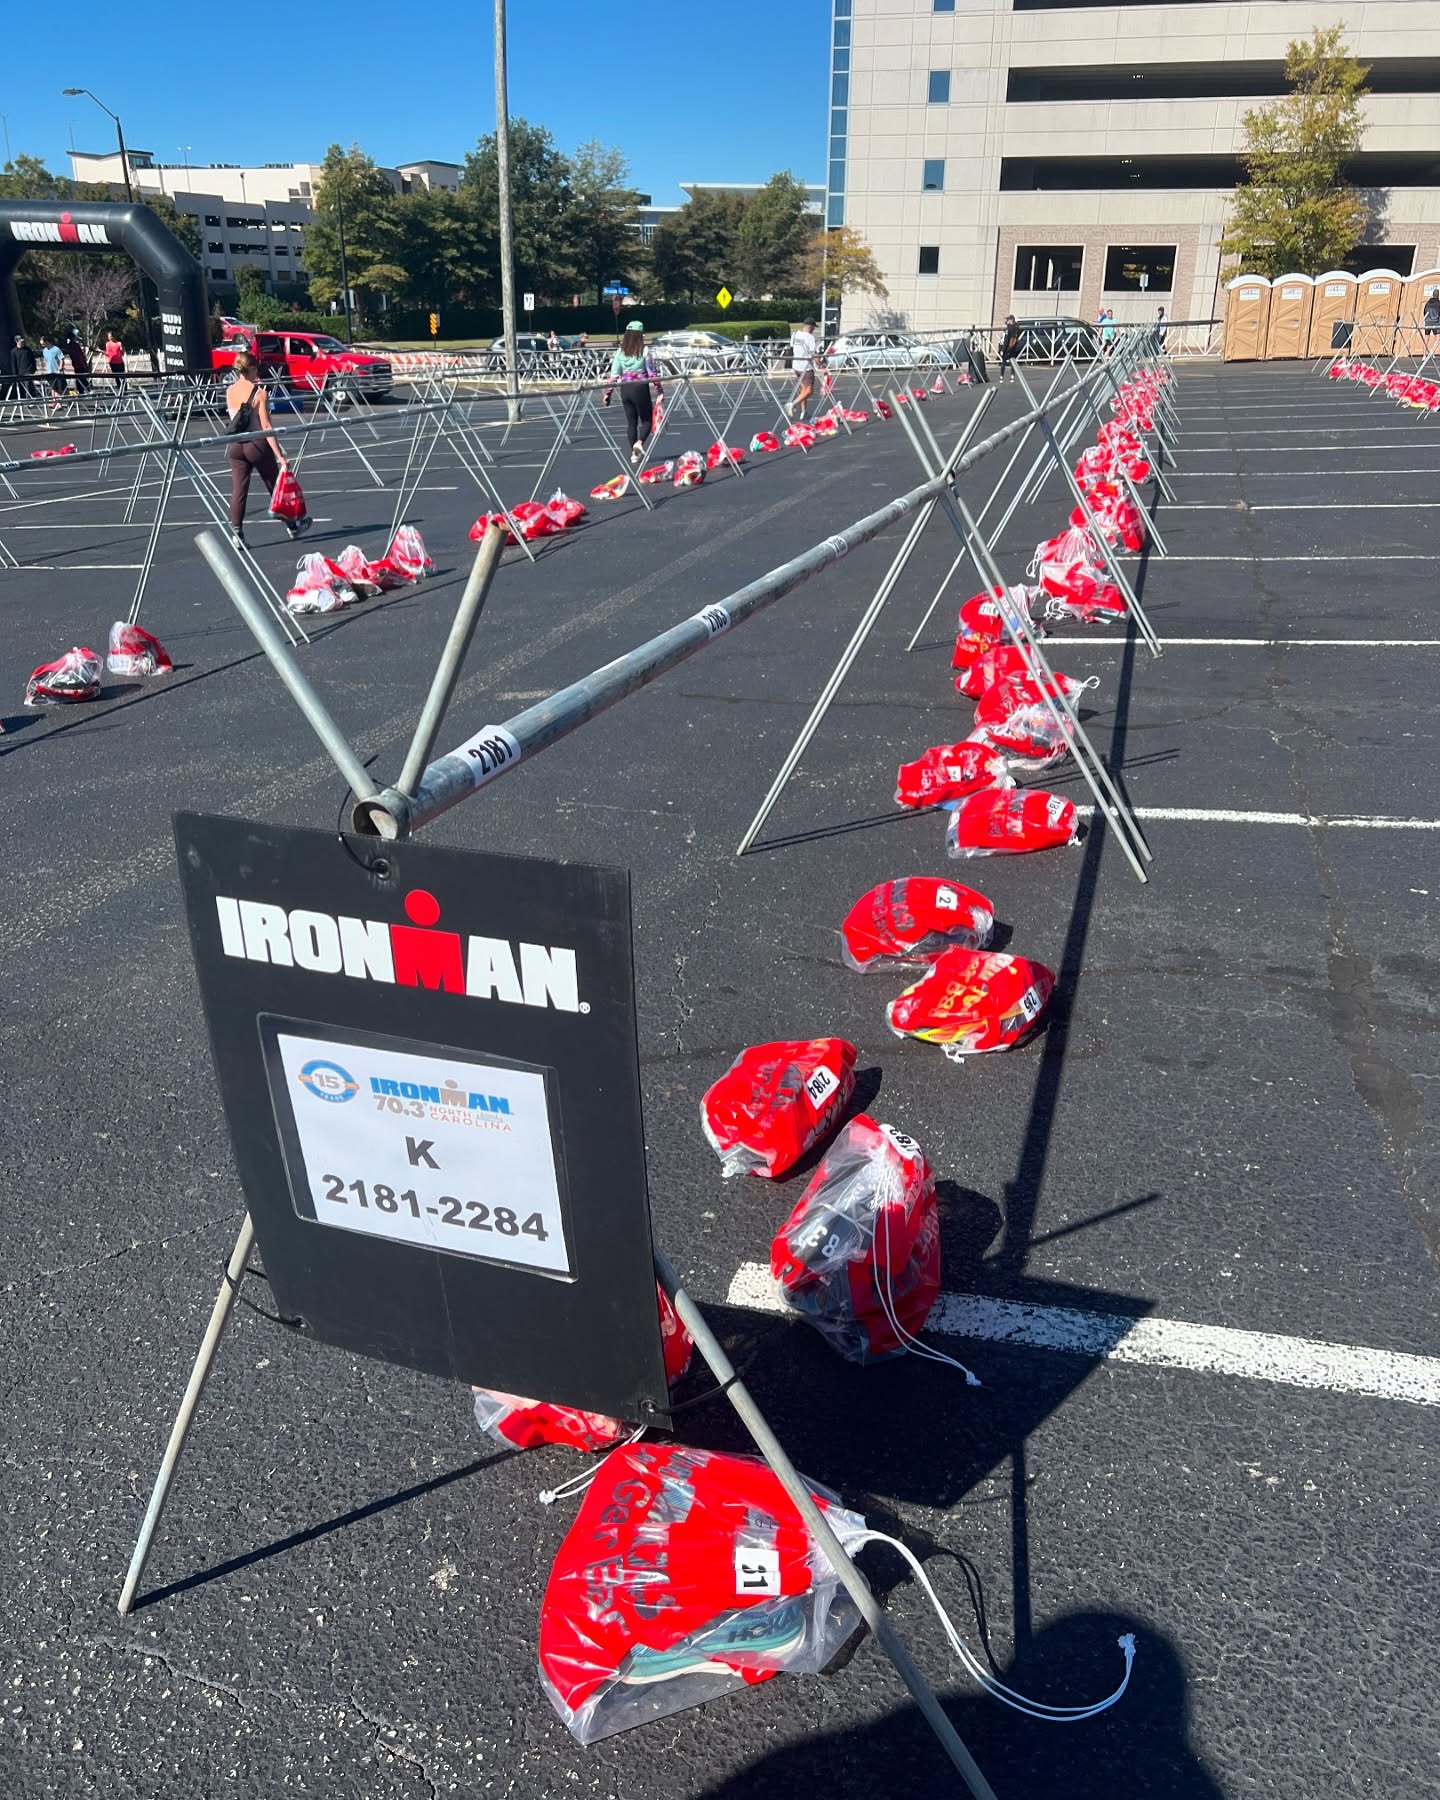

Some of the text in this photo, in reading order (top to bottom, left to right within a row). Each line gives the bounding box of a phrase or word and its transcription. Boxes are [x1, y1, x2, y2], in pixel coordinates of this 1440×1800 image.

[10, 212, 111, 244] IRONMAN
[162, 313, 182, 325] RUN
[163, 324, 182, 335] OUT
[467, 735, 513, 776] 2181
[216, 889, 579, 1013] IRONMAN
[314, 1073, 340, 1089] 15
[809, 1071, 831, 1100] 2184
[369, 1077, 510, 1115] IRONMAN
[373, 1094, 425, 1118] 70.3
[429, 1105, 472, 1118] NORTH
[430, 1112, 512, 1131] CAROLINA
[405, 1136, 441, 1170] K
[322, 1174, 549, 1241] 2181-2284
